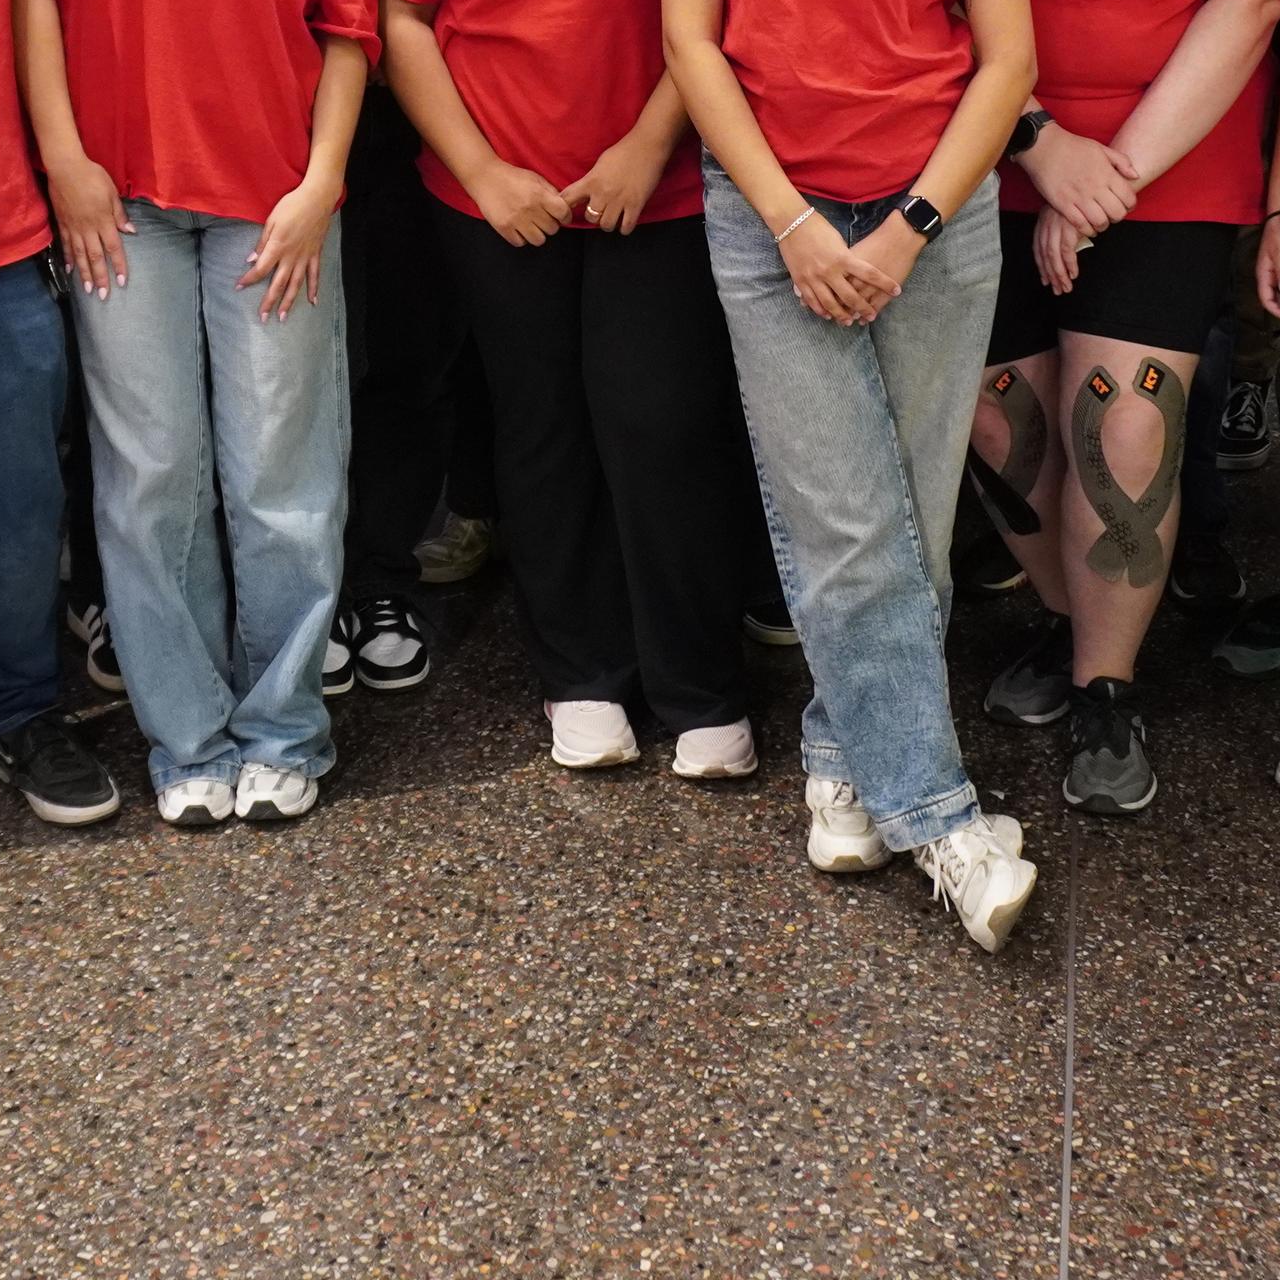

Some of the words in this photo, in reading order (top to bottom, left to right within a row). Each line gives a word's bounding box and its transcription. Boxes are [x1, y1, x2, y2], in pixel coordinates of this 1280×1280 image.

[995, 371, 1011, 391] KT
[1092, 376, 1111, 395] KT
[1142, 366, 1159, 391] KT
